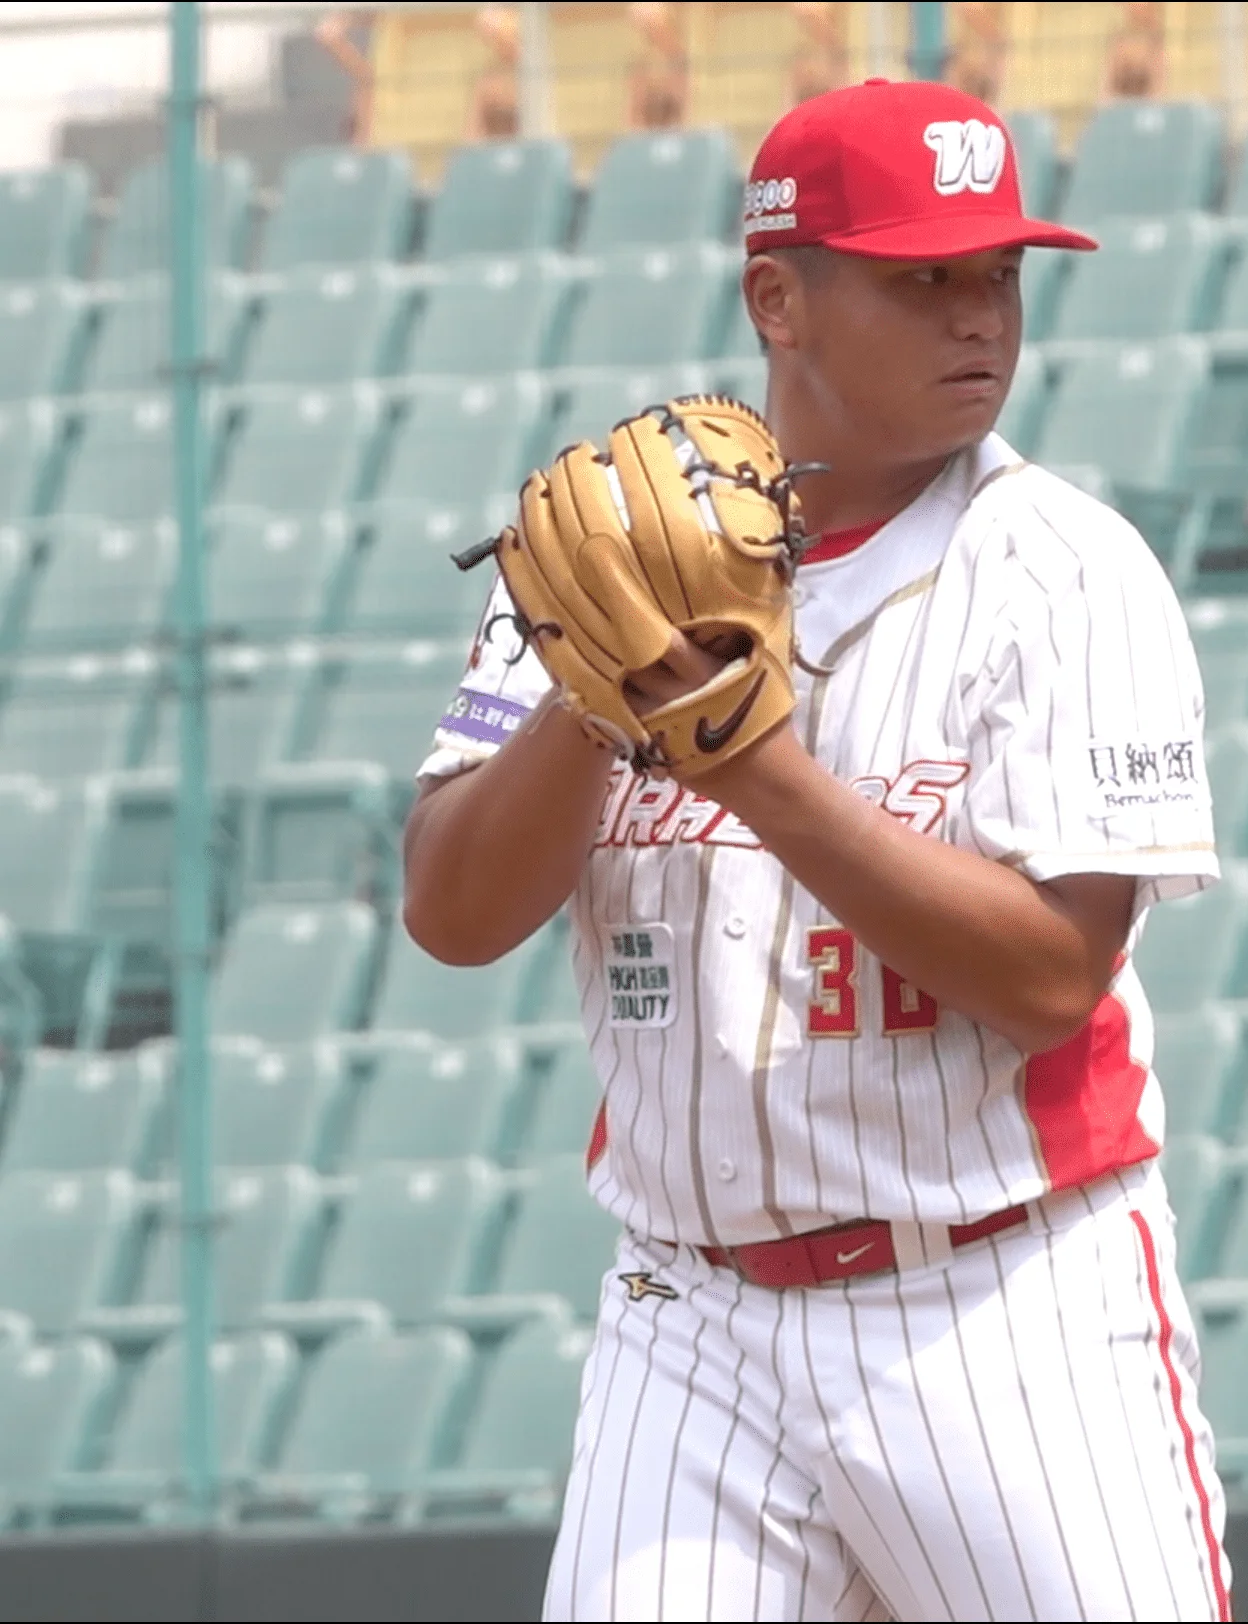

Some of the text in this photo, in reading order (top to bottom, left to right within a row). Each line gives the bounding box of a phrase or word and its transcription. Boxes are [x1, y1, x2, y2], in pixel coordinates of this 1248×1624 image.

[924, 119, 1006, 196] W
[1088, 740, 1199, 788] 貝納頌
